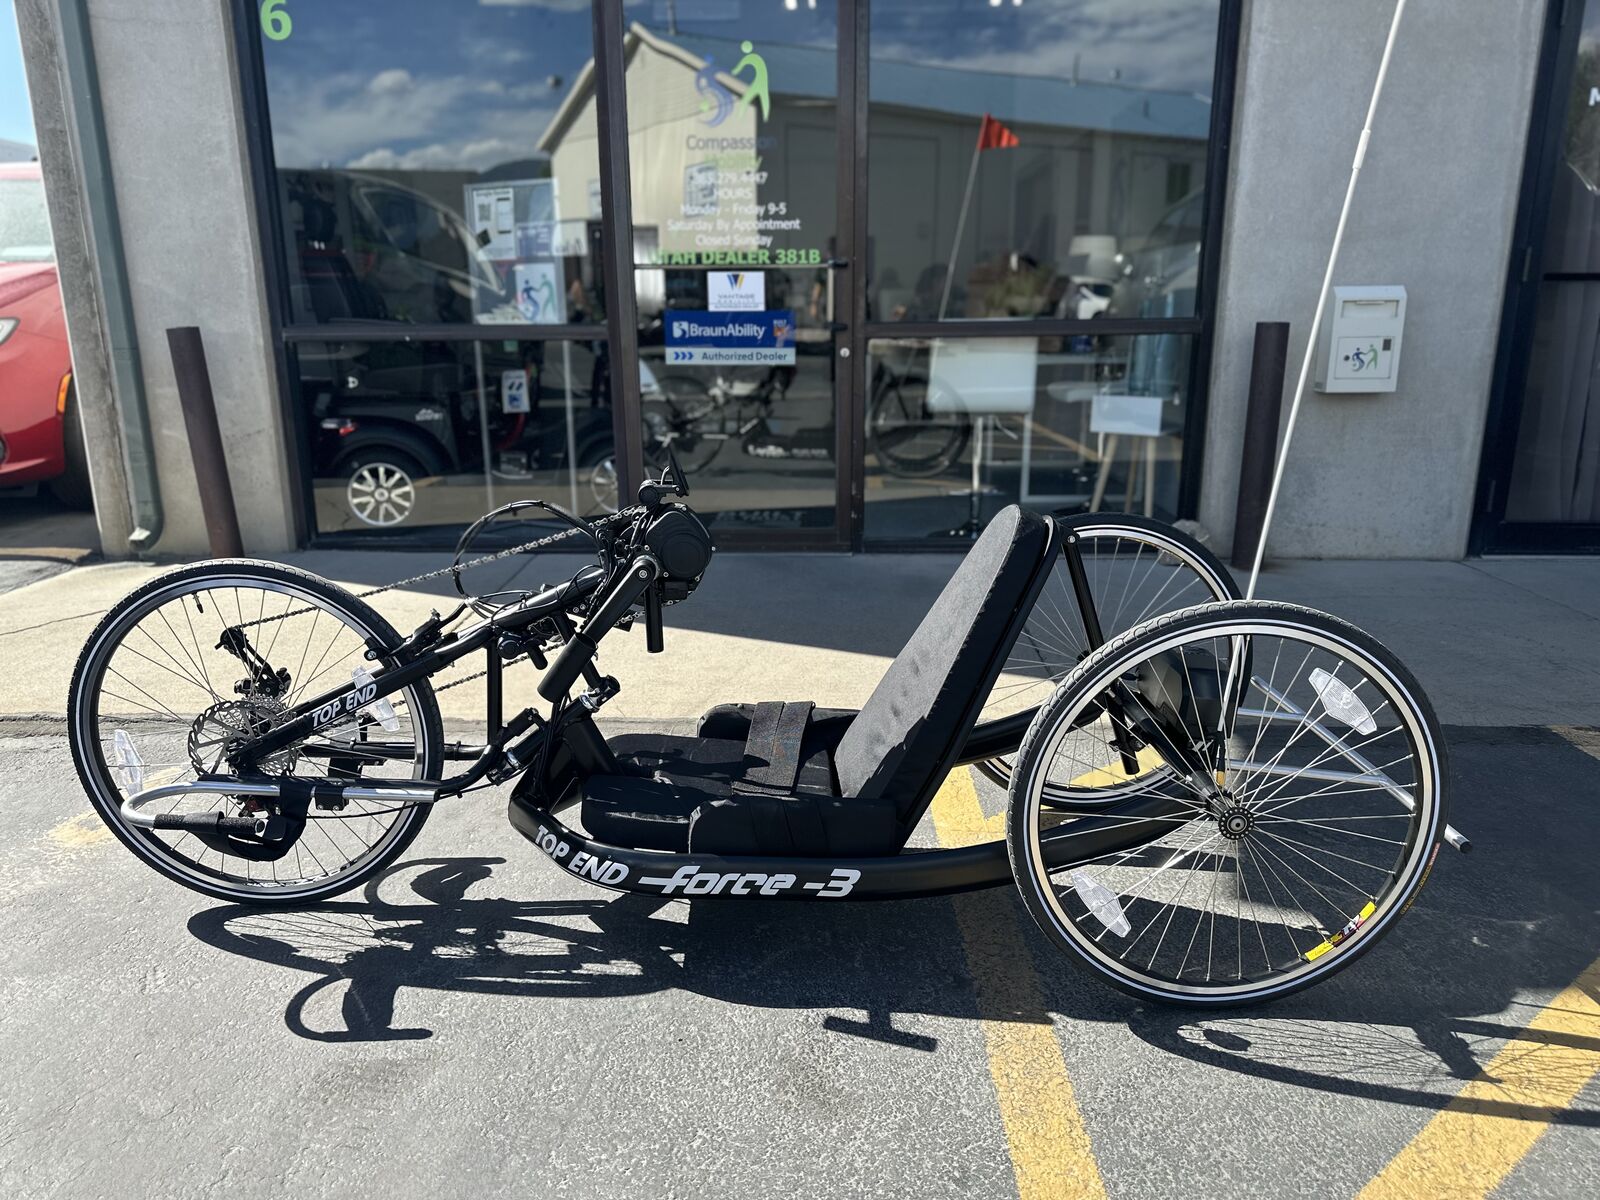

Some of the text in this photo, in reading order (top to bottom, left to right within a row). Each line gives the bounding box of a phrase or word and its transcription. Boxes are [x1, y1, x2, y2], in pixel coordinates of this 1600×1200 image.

[261, 0, 292, 40] 6
[768, 202, 787, 215] 9-5
[702, 250, 770, 264] DEALER
[775, 249, 821, 264] 381B
[689, 323, 765, 340] BraunAbility
[702, 352, 787, 361] Authorized Dealer
[312, 683, 377, 727] TOP END
[534, 824, 629, 886] TOP END
[638, 865, 797, 896] force
